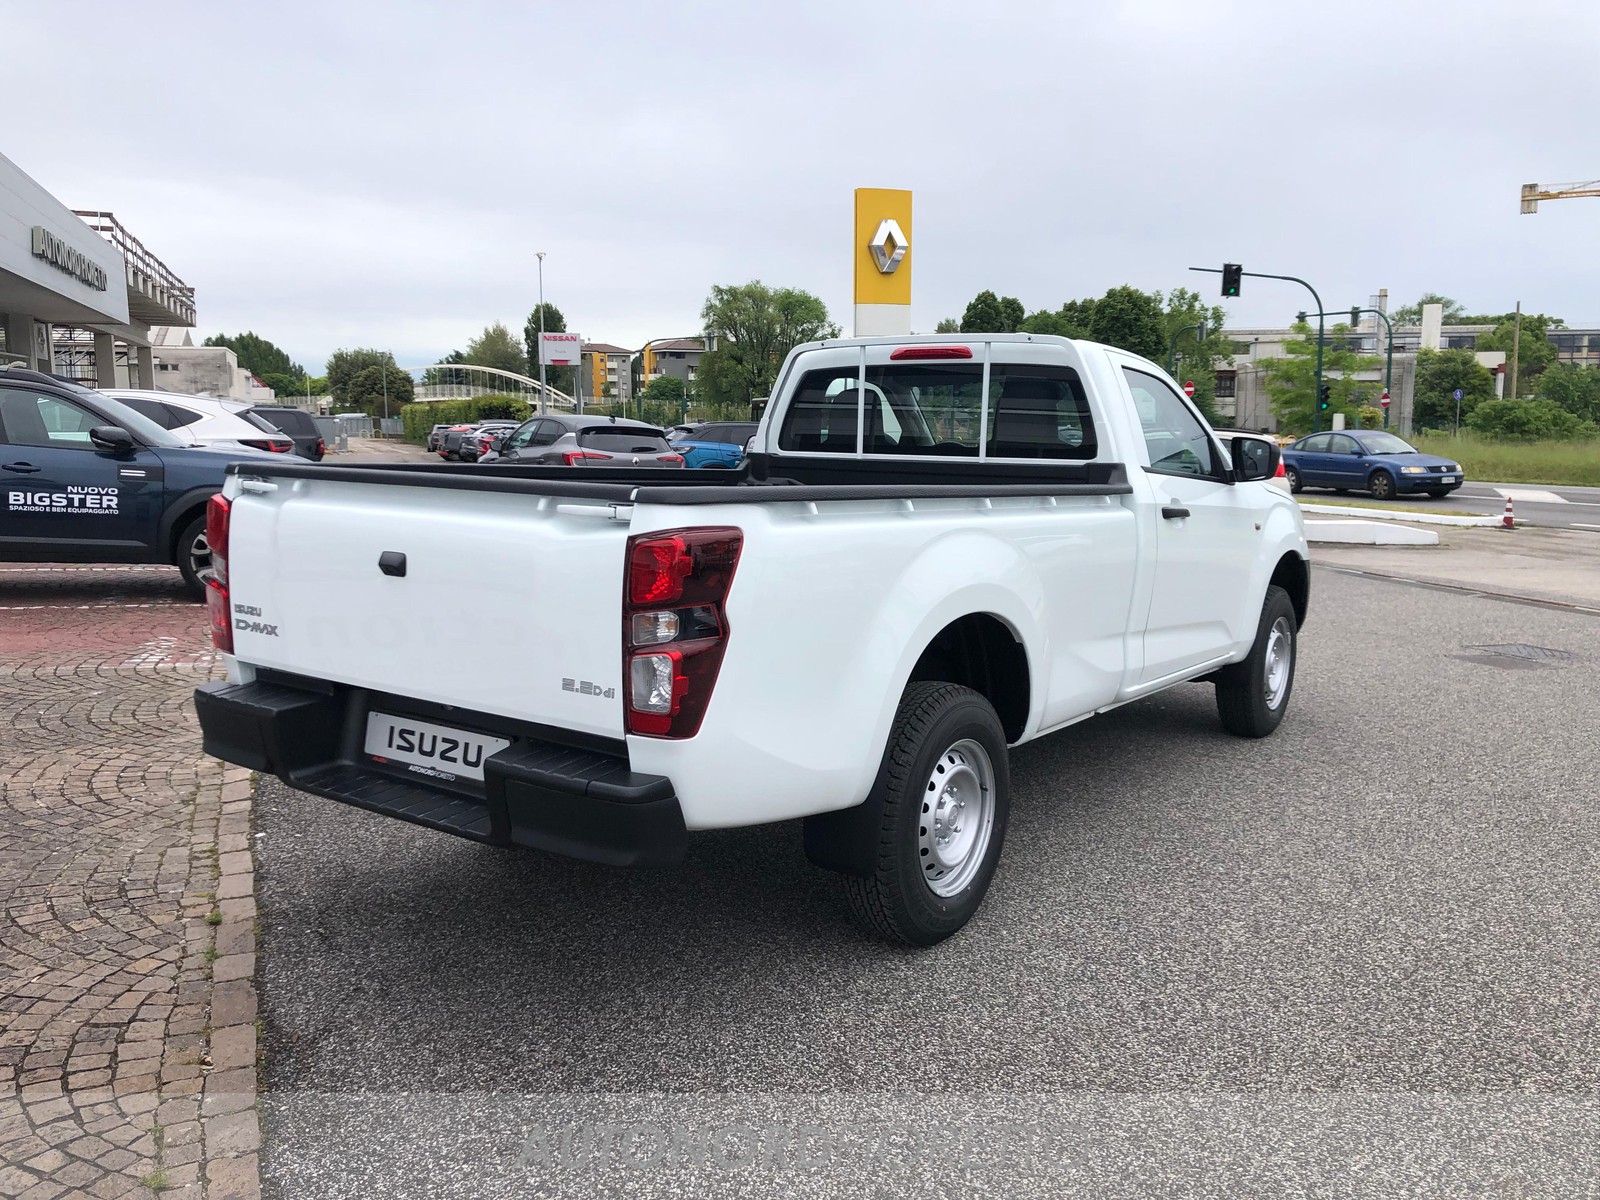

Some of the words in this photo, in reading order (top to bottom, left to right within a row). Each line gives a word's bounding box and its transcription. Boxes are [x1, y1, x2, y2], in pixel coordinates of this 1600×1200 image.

[67, 485, 119, 495] NUOVO
[8, 491, 119, 508] BIGSTER
[234, 603, 262, 618] ISUZU
[387, 725, 483, 768] ISUZU
